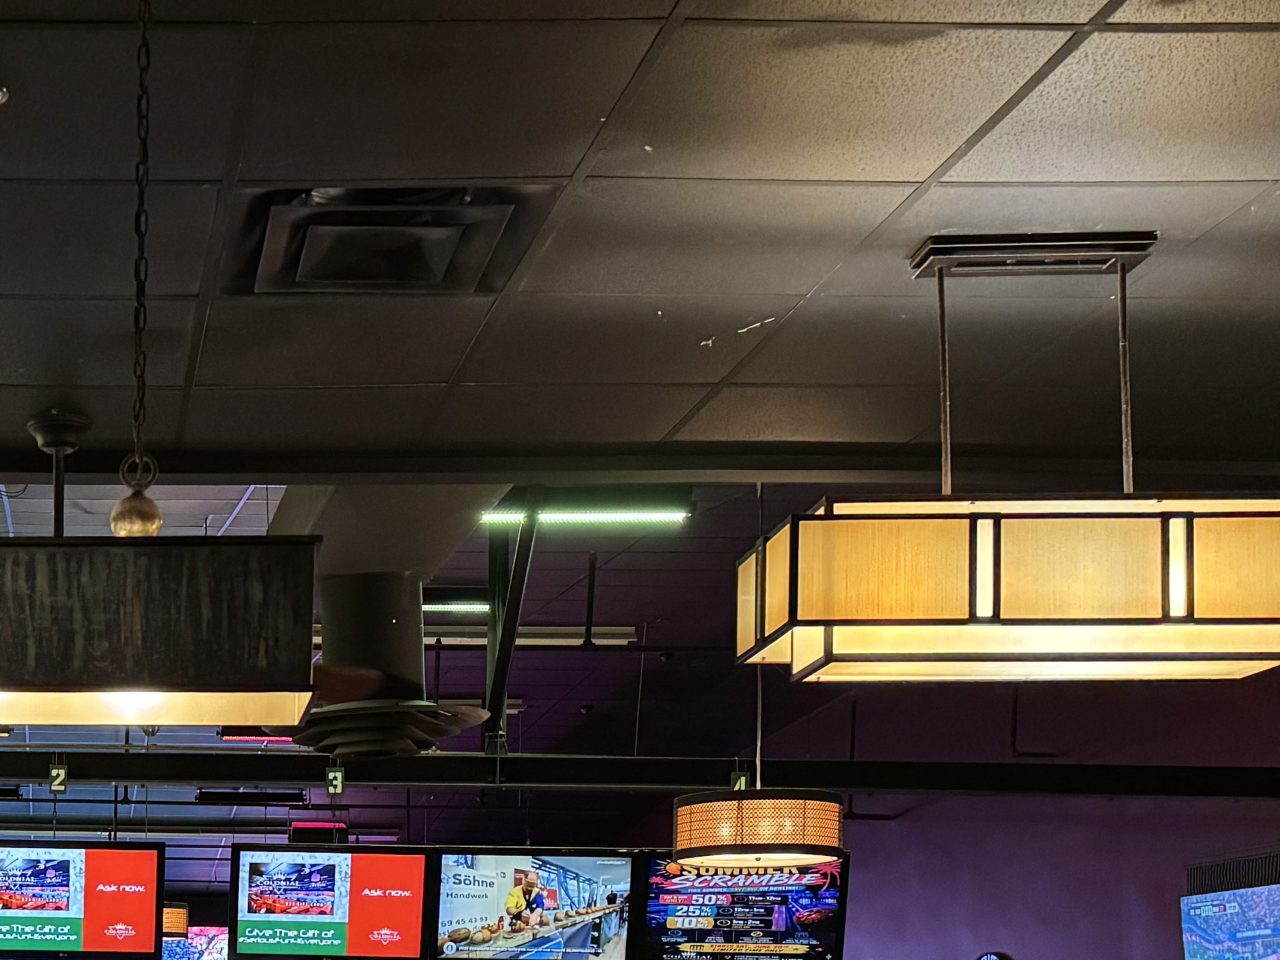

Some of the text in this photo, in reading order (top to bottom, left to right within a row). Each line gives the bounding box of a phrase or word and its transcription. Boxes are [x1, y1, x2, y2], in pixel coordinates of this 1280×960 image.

[51, 769, 65, 791] 2
[328, 771, 343, 794] 3
[682, 865, 799, 876] SUMMER
[452, 873, 495, 888] Söhne
[664, 873, 821, 890] SCRAMBLE
[96, 883, 118, 892] Ask
[361, 887, 413, 897] Ask now.
[446, 891, 488, 899] Handwerk
[11, 924, 35, 932] The
[36, 925, 57, 933] Gift
[58, 925, 70, 933] of
[440, 920, 452, 928] 69
[245, 928, 335, 938] Give The Gift of
